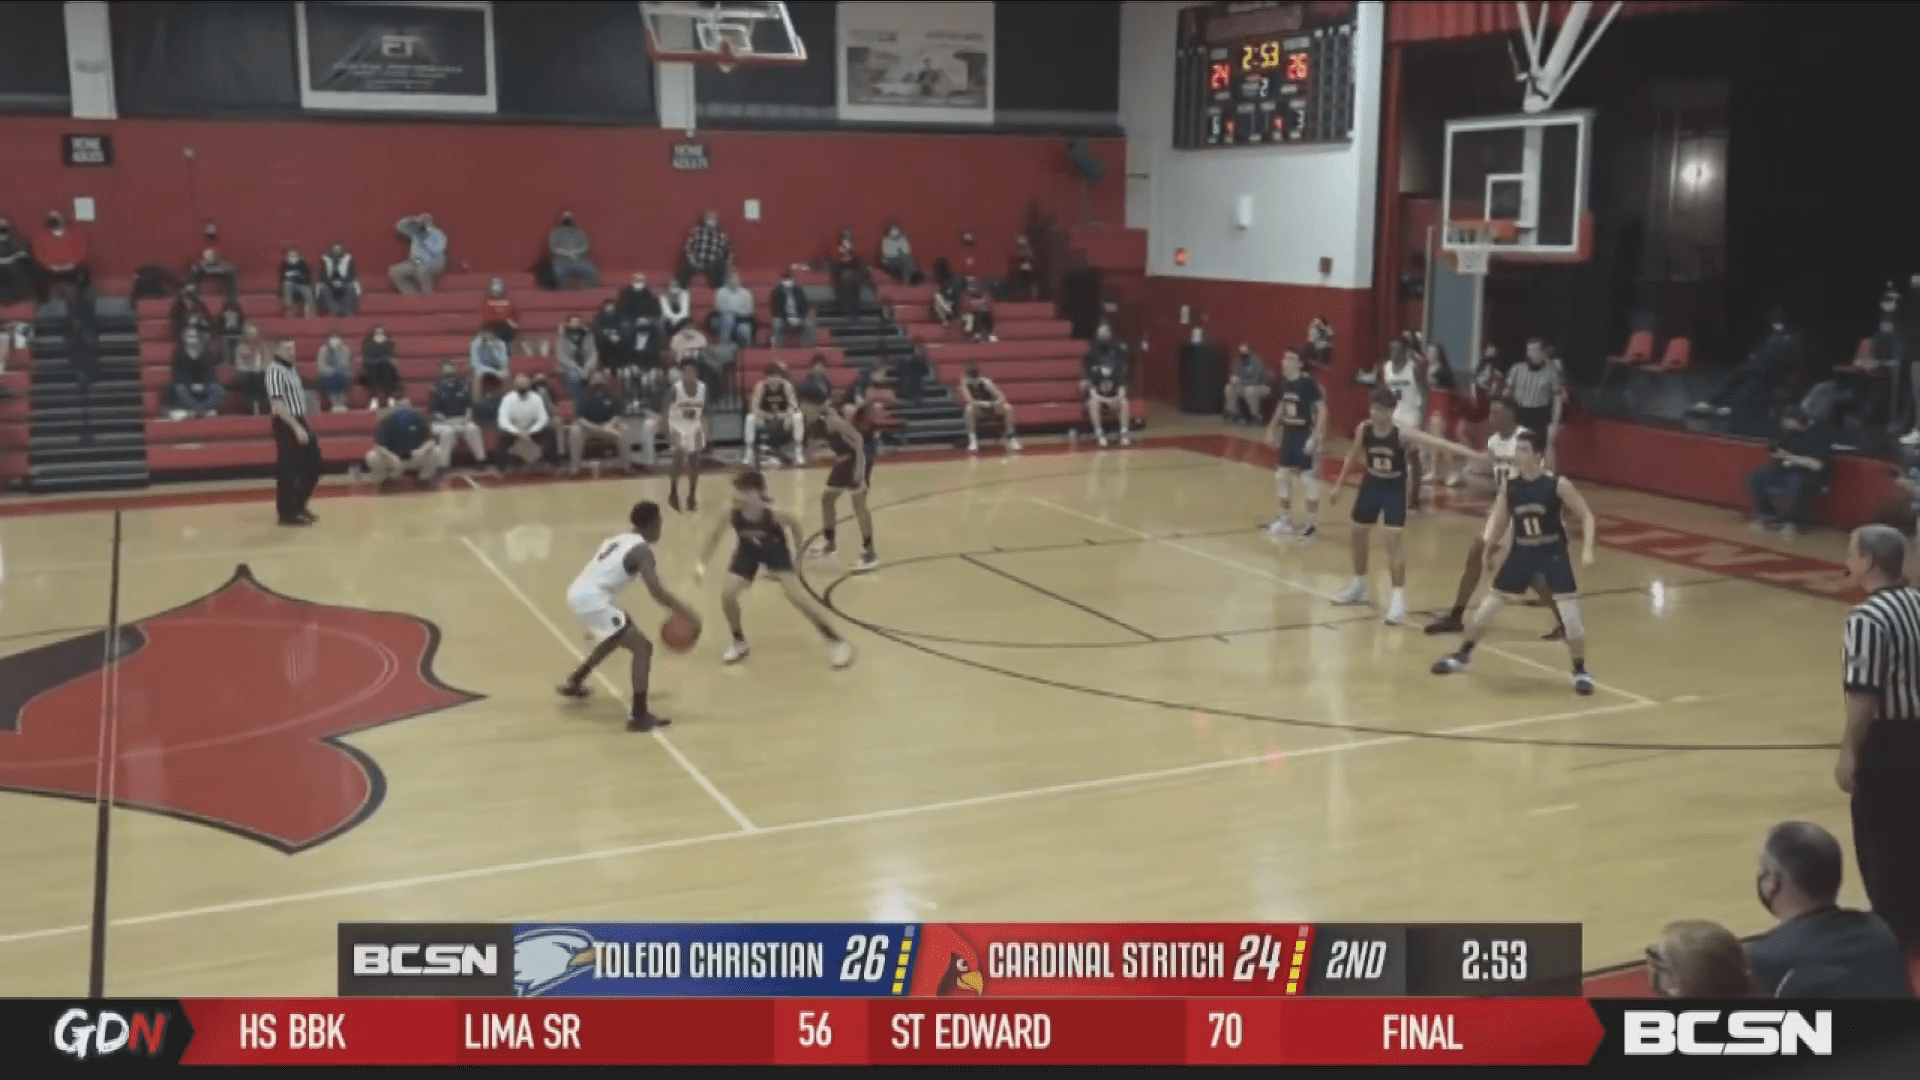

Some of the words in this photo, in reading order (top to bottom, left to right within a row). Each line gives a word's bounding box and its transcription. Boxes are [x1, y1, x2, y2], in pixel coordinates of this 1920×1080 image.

[1242, 41, 1280, 70] 2:53
[1286, 53, 1308, 80] 26
[1211, 63, 1231, 90] 24
[1523, 517, 1542, 536] 11
